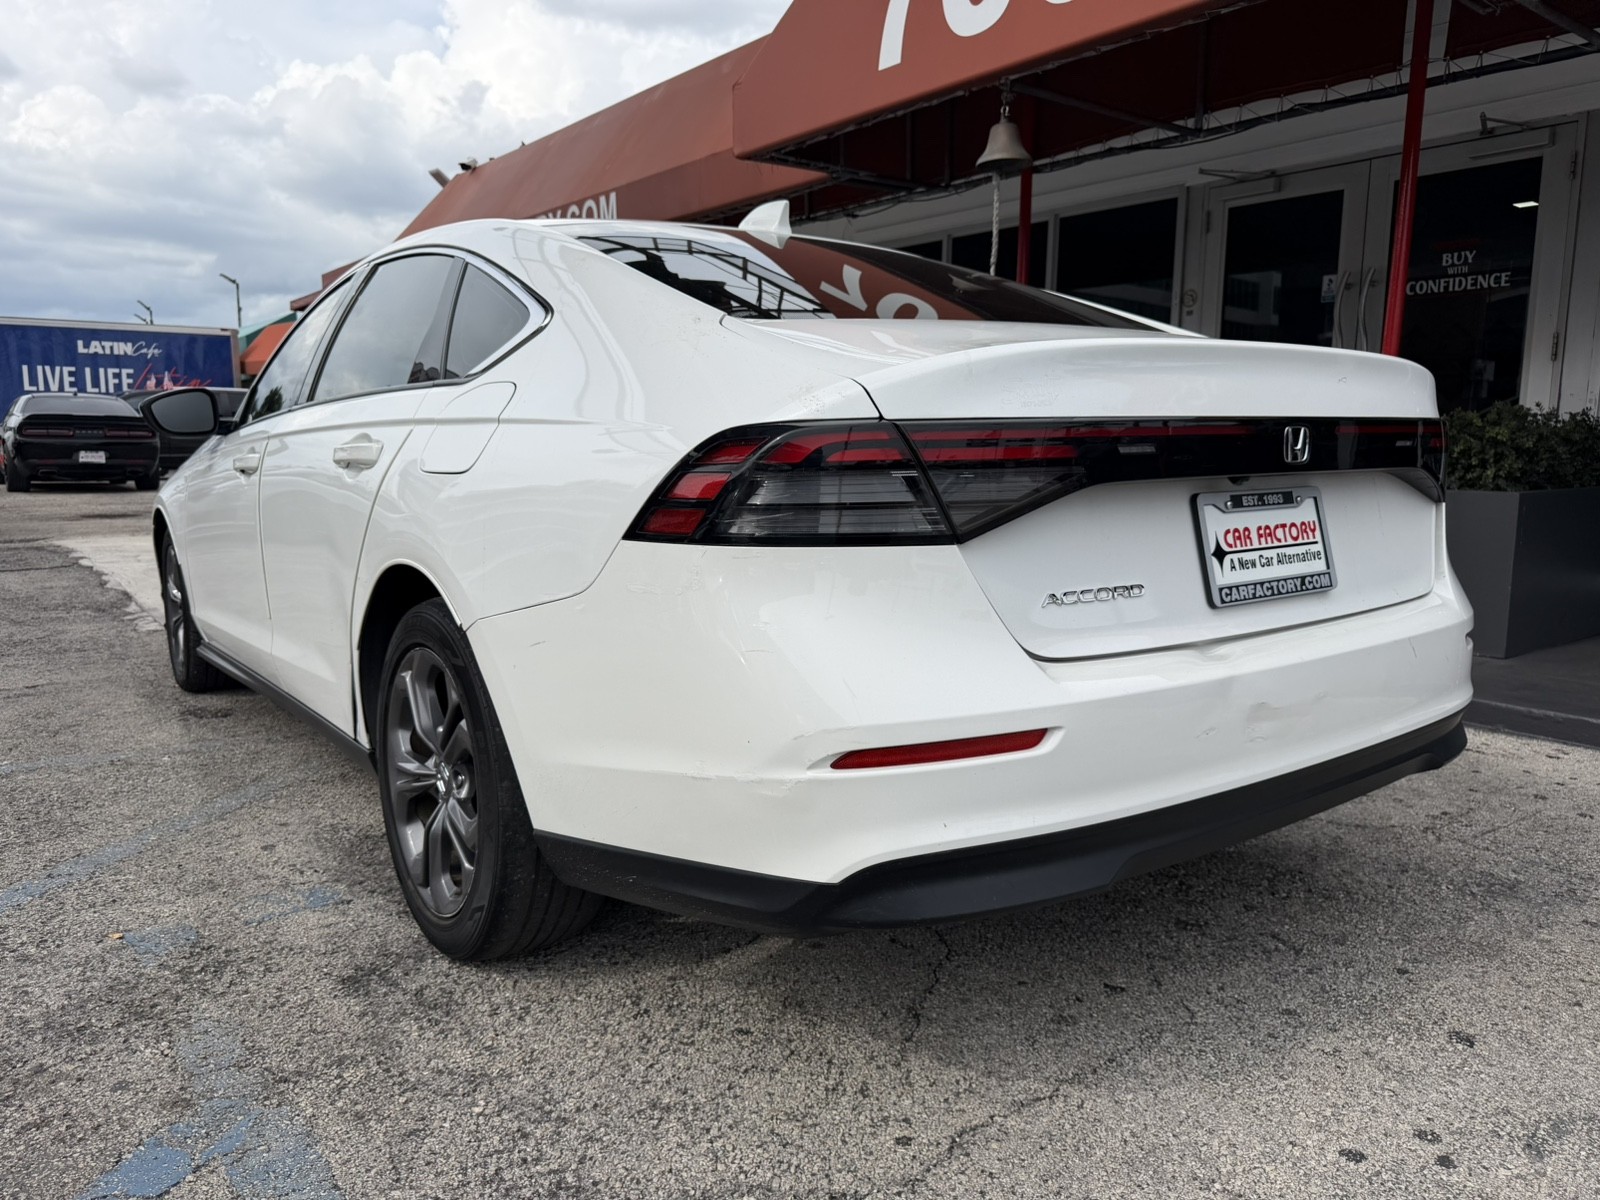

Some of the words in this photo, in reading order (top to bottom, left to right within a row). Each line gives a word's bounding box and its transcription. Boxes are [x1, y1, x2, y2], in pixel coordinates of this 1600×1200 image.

[1442, 250, 1477, 267] BUY
[1447, 266, 1468, 275] WITH
[1406, 272, 1511, 295] CONFIDENCE
[77, 340, 132, 355] LATIN
[22, 365, 78, 392] LIVE
[84, 367, 134, 393] LIFE
[1241, 495, 1262, 506] EST.
[1263, 494, 1284, 505] 1993
[1223, 527, 1253, 549] CAR
[1256, 520, 1317, 545] FACTORY
[1230, 561, 1237, 572] A
[1237, 557, 1257, 571] New
[1258, 554, 1274, 568] Car
[1276, 548, 1322, 566] Alternative
[1041, 583, 1145, 608] ACCORD
[1221, 573, 1330, 602] CARFACTORY.COM
